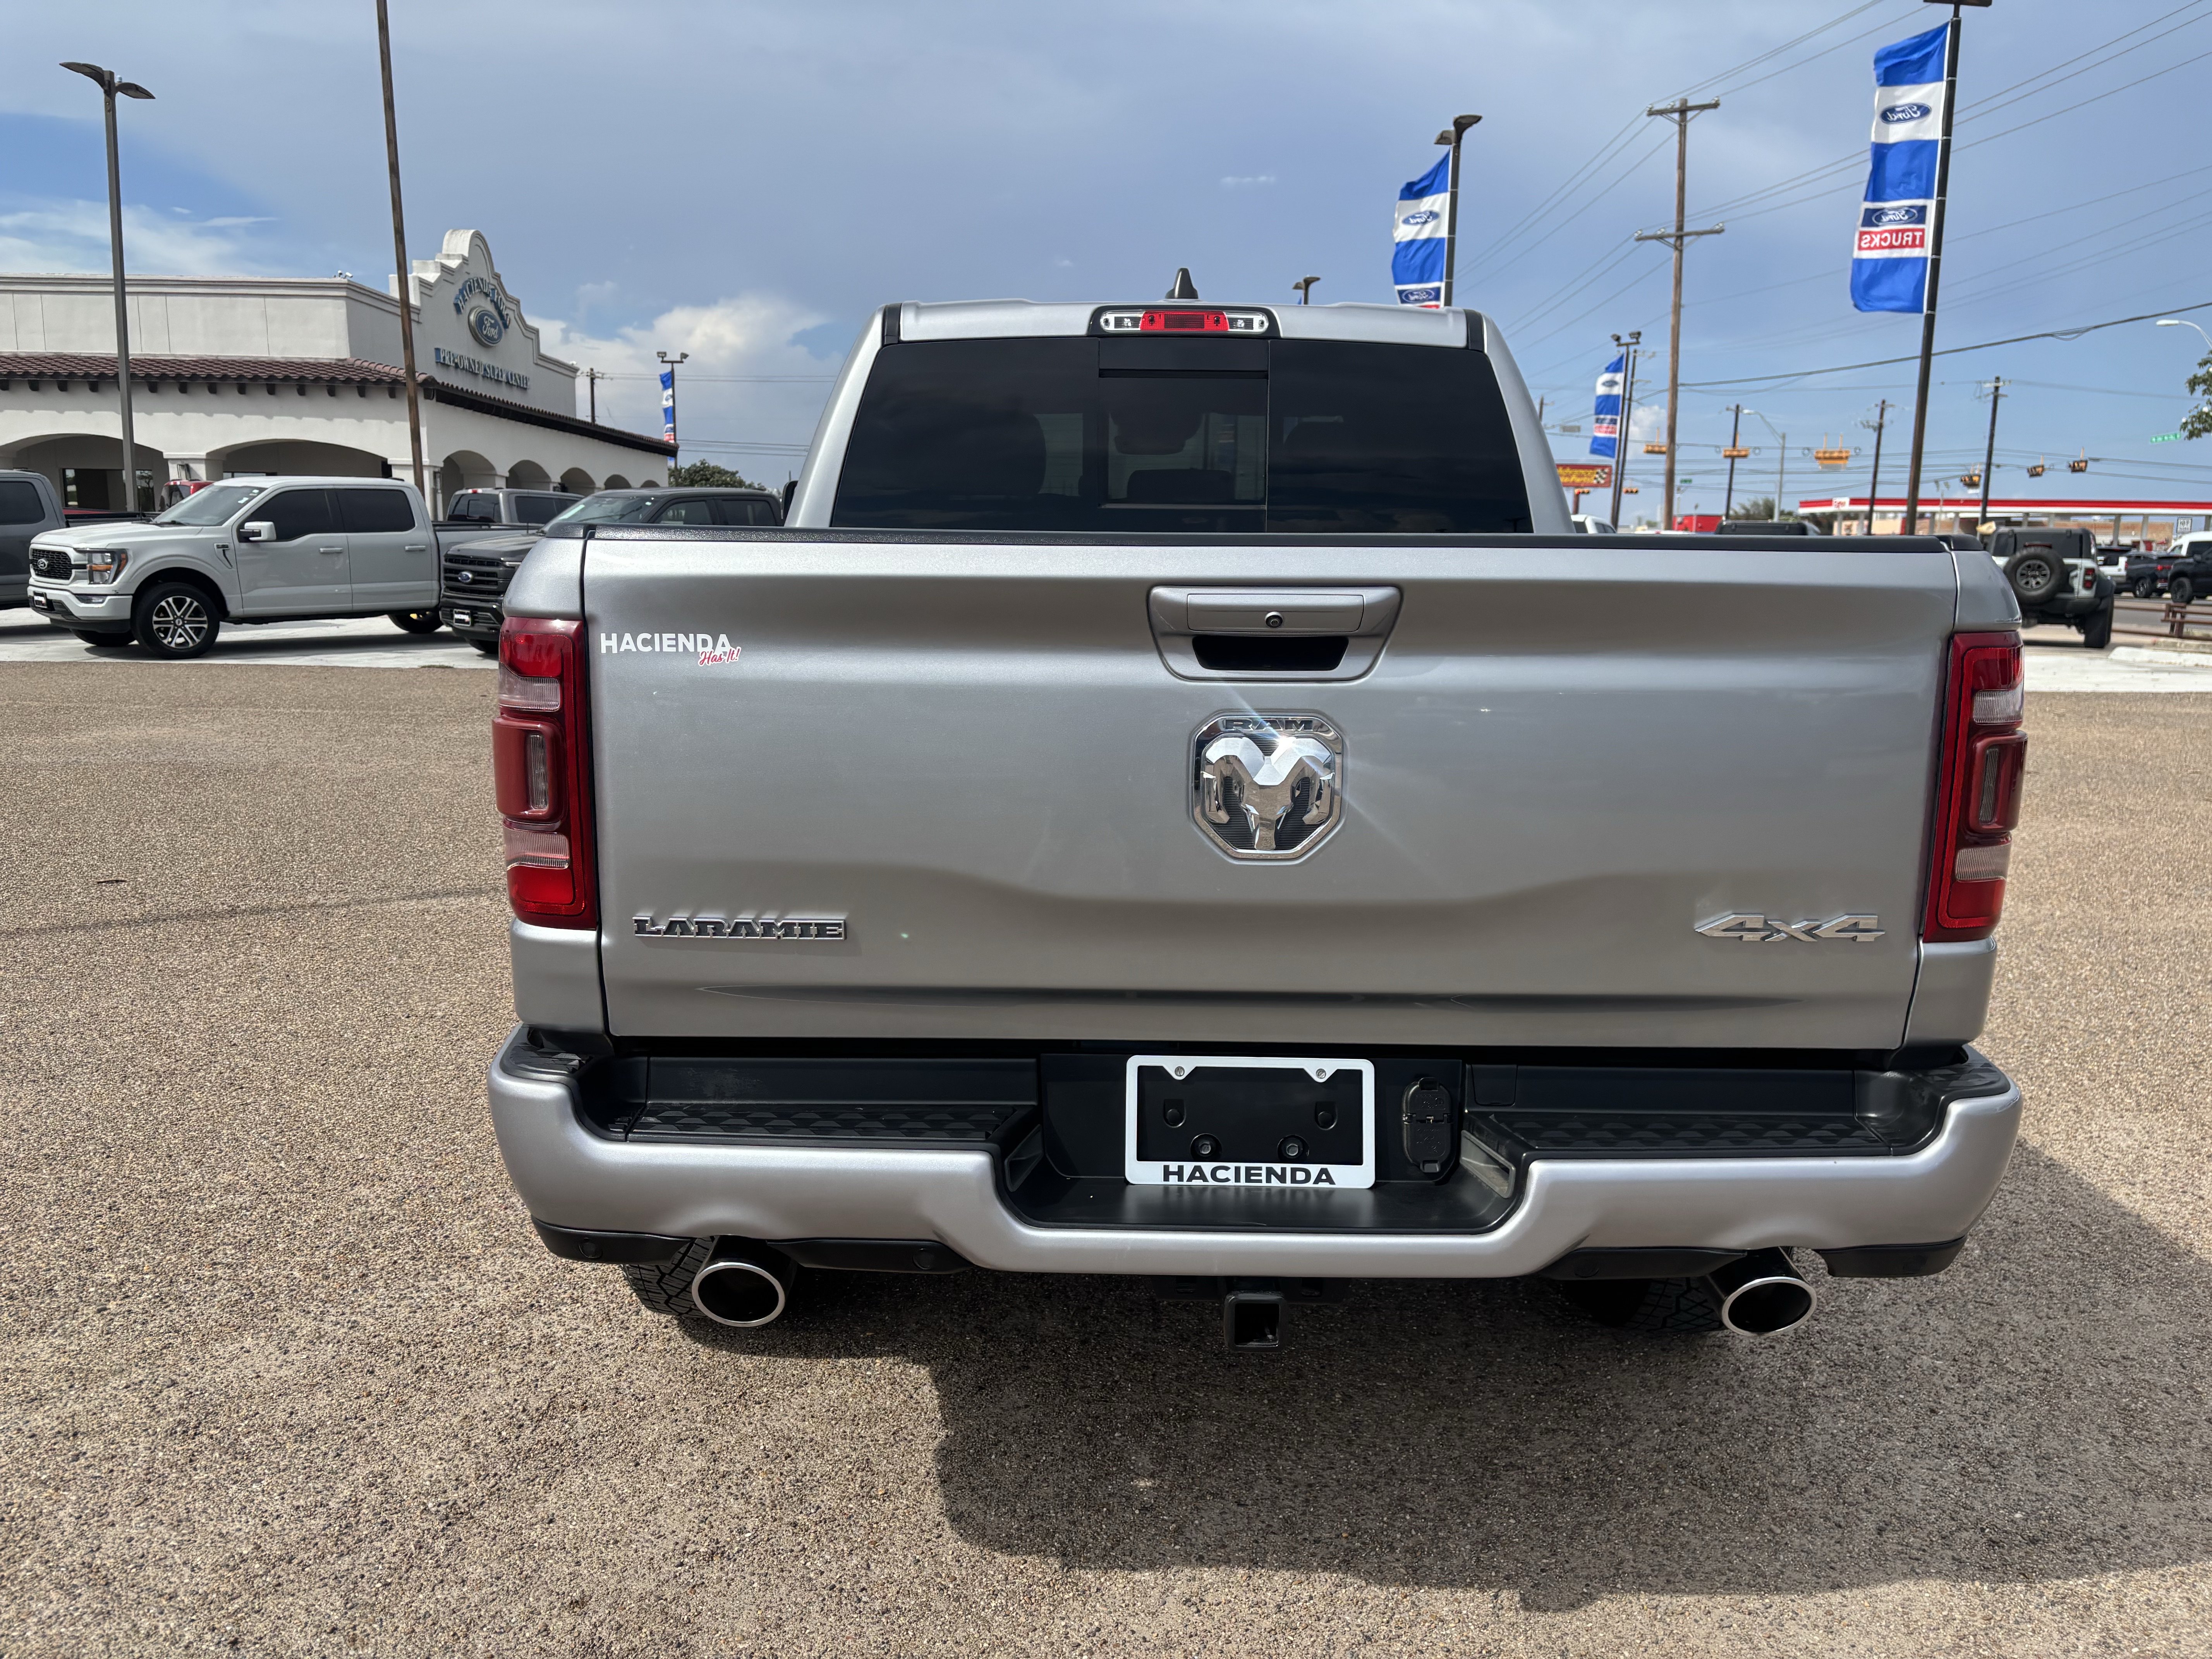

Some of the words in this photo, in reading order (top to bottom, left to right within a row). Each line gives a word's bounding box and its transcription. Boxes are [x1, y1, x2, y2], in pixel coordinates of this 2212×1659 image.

[482, 316, 499, 339] Ford
[600, 633, 732, 654] HACIENDA
[699, 651, 722, 665] Has
[1224, 718, 1314, 731] RAM
[632, 916, 848, 941] LARAMIE
[1163, 1164, 1336, 1185] HACIENDA
